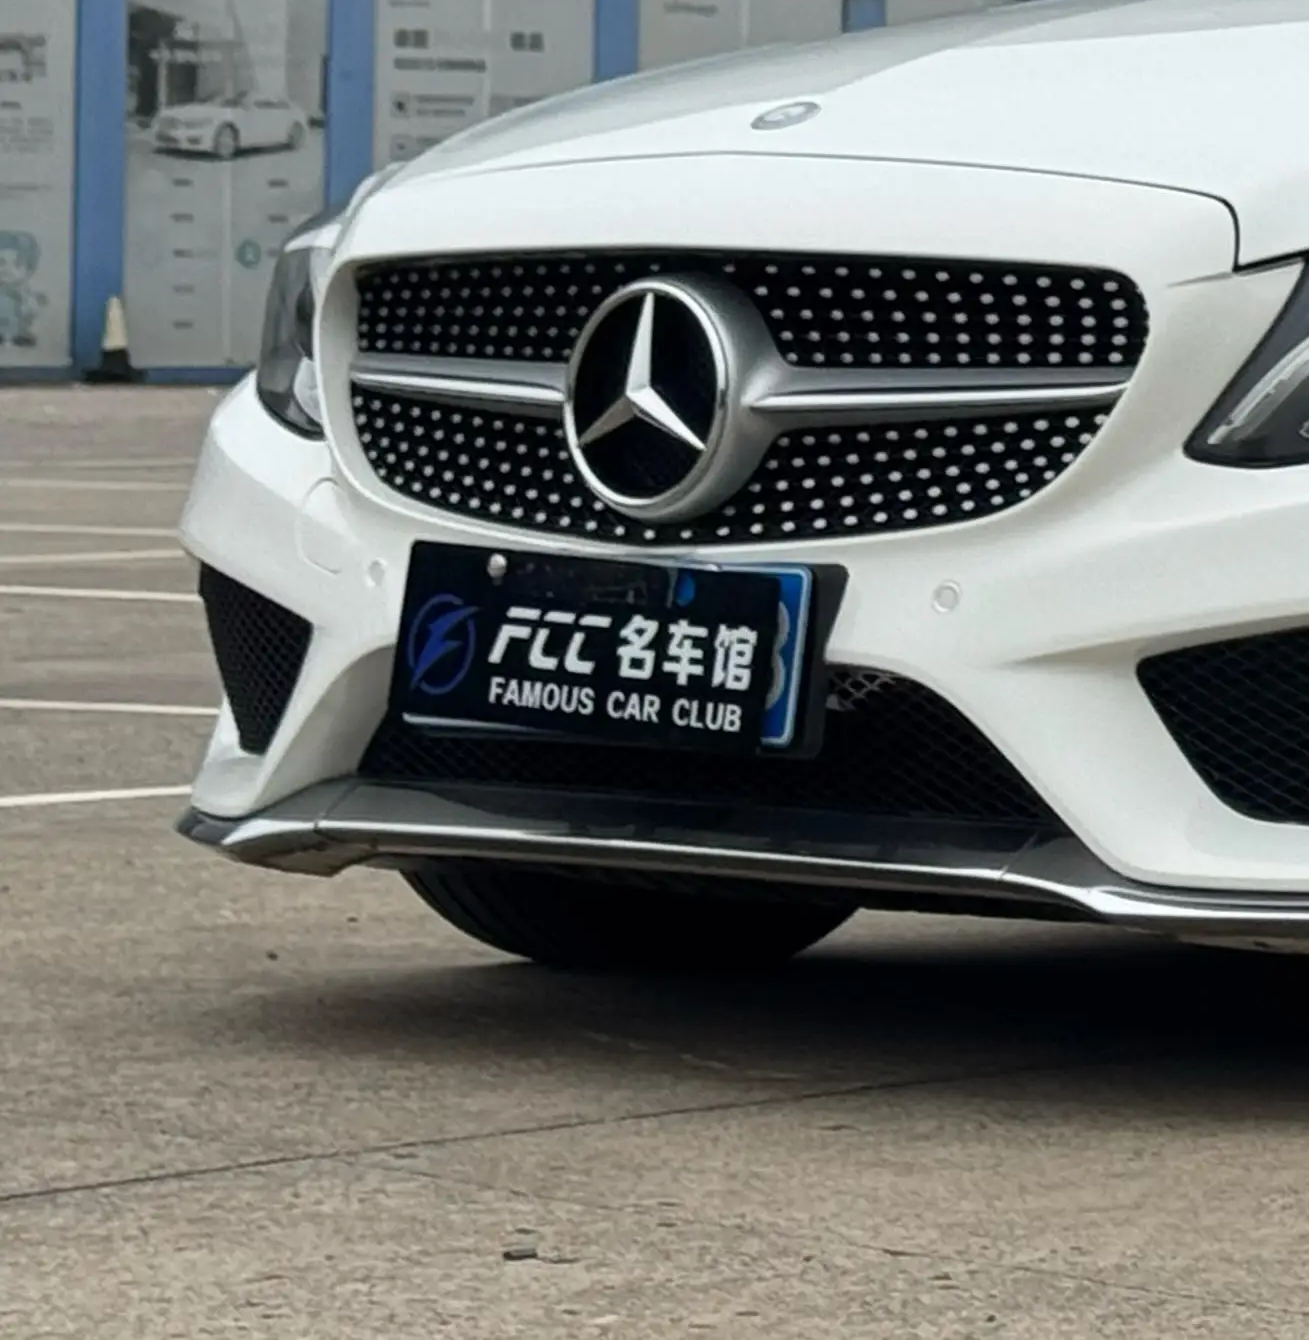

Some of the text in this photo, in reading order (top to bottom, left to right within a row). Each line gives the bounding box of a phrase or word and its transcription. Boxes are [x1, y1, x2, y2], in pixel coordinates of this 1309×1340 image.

[488, 606, 613, 675] FCC
[616, 614, 758, 691] 名车馆
[488, 676, 743, 733] FAMOUS CAR CLUB
